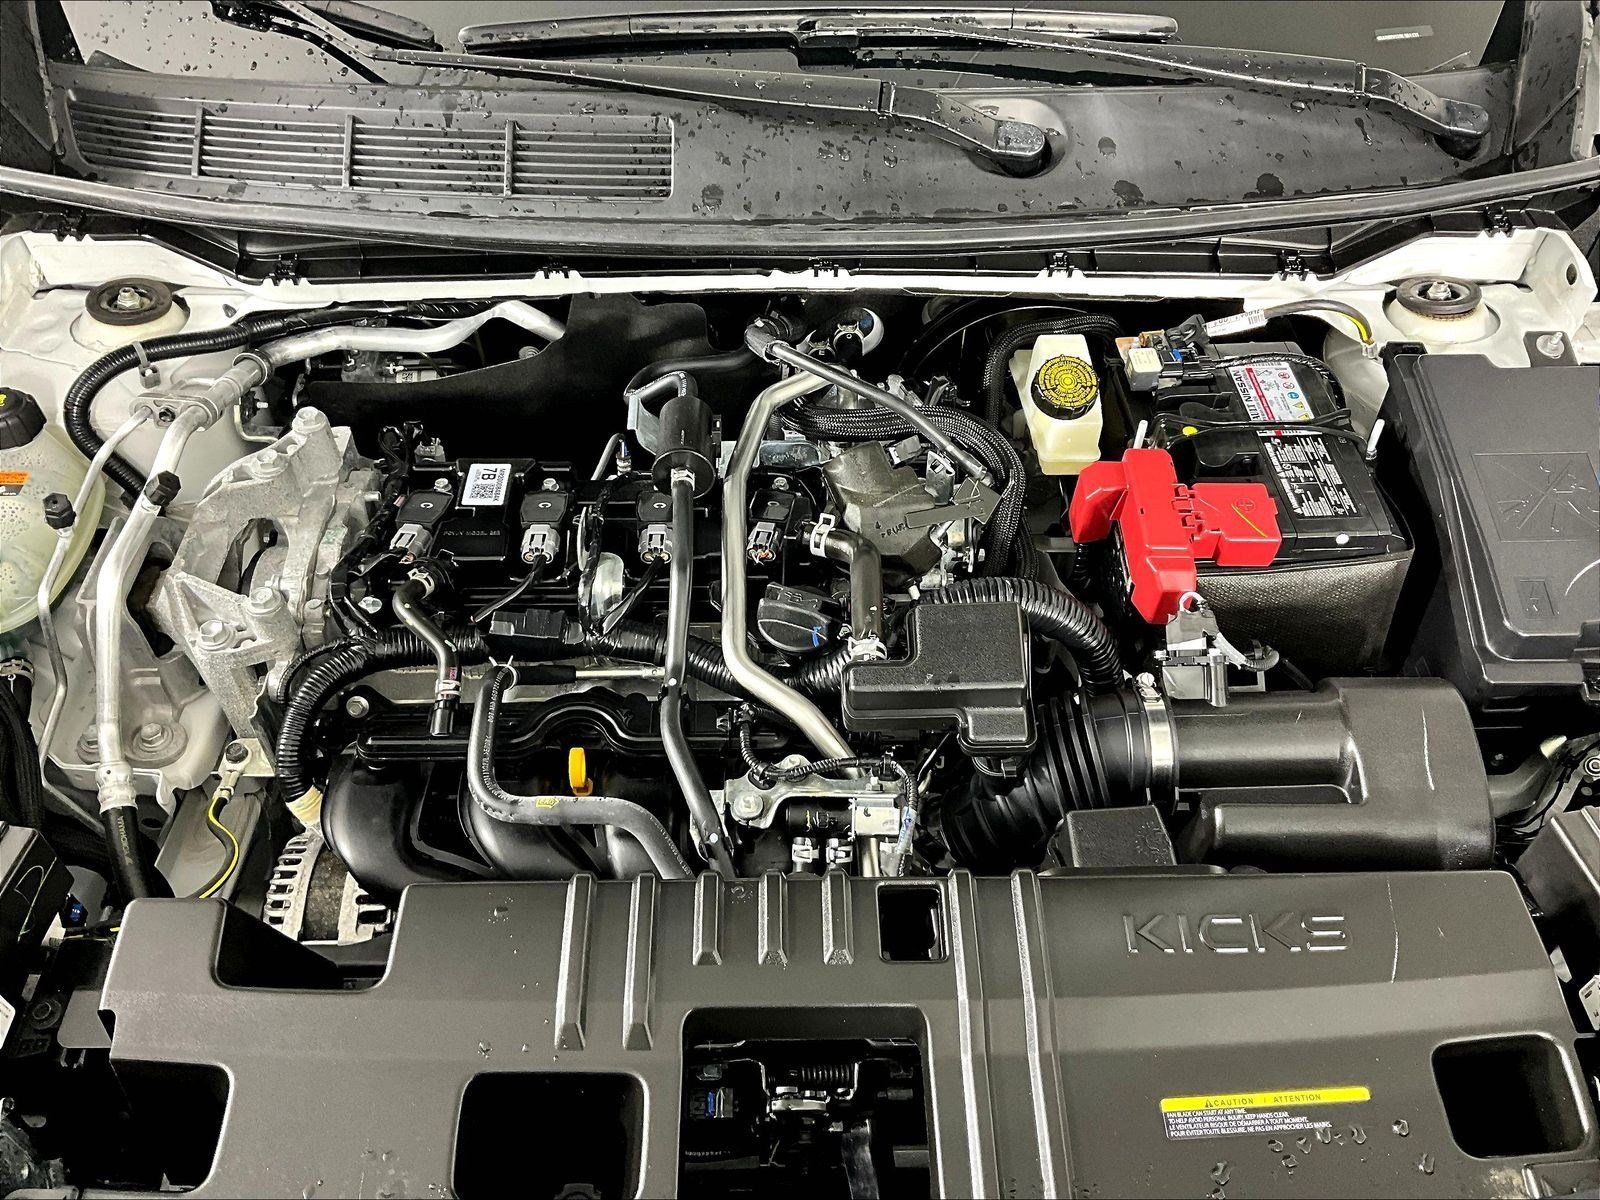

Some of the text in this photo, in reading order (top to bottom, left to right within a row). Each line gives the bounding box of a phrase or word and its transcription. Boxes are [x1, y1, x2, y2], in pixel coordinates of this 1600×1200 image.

[1233, 370, 1253, 402] NISSAN
[482, 468, 498, 480] 7B
[117, 815, 130, 857] YOKOHAMA
[1122, 913, 1348, 953] KICKS
[1213, 1094, 1321, 1107] CAUTION ATTENTION
